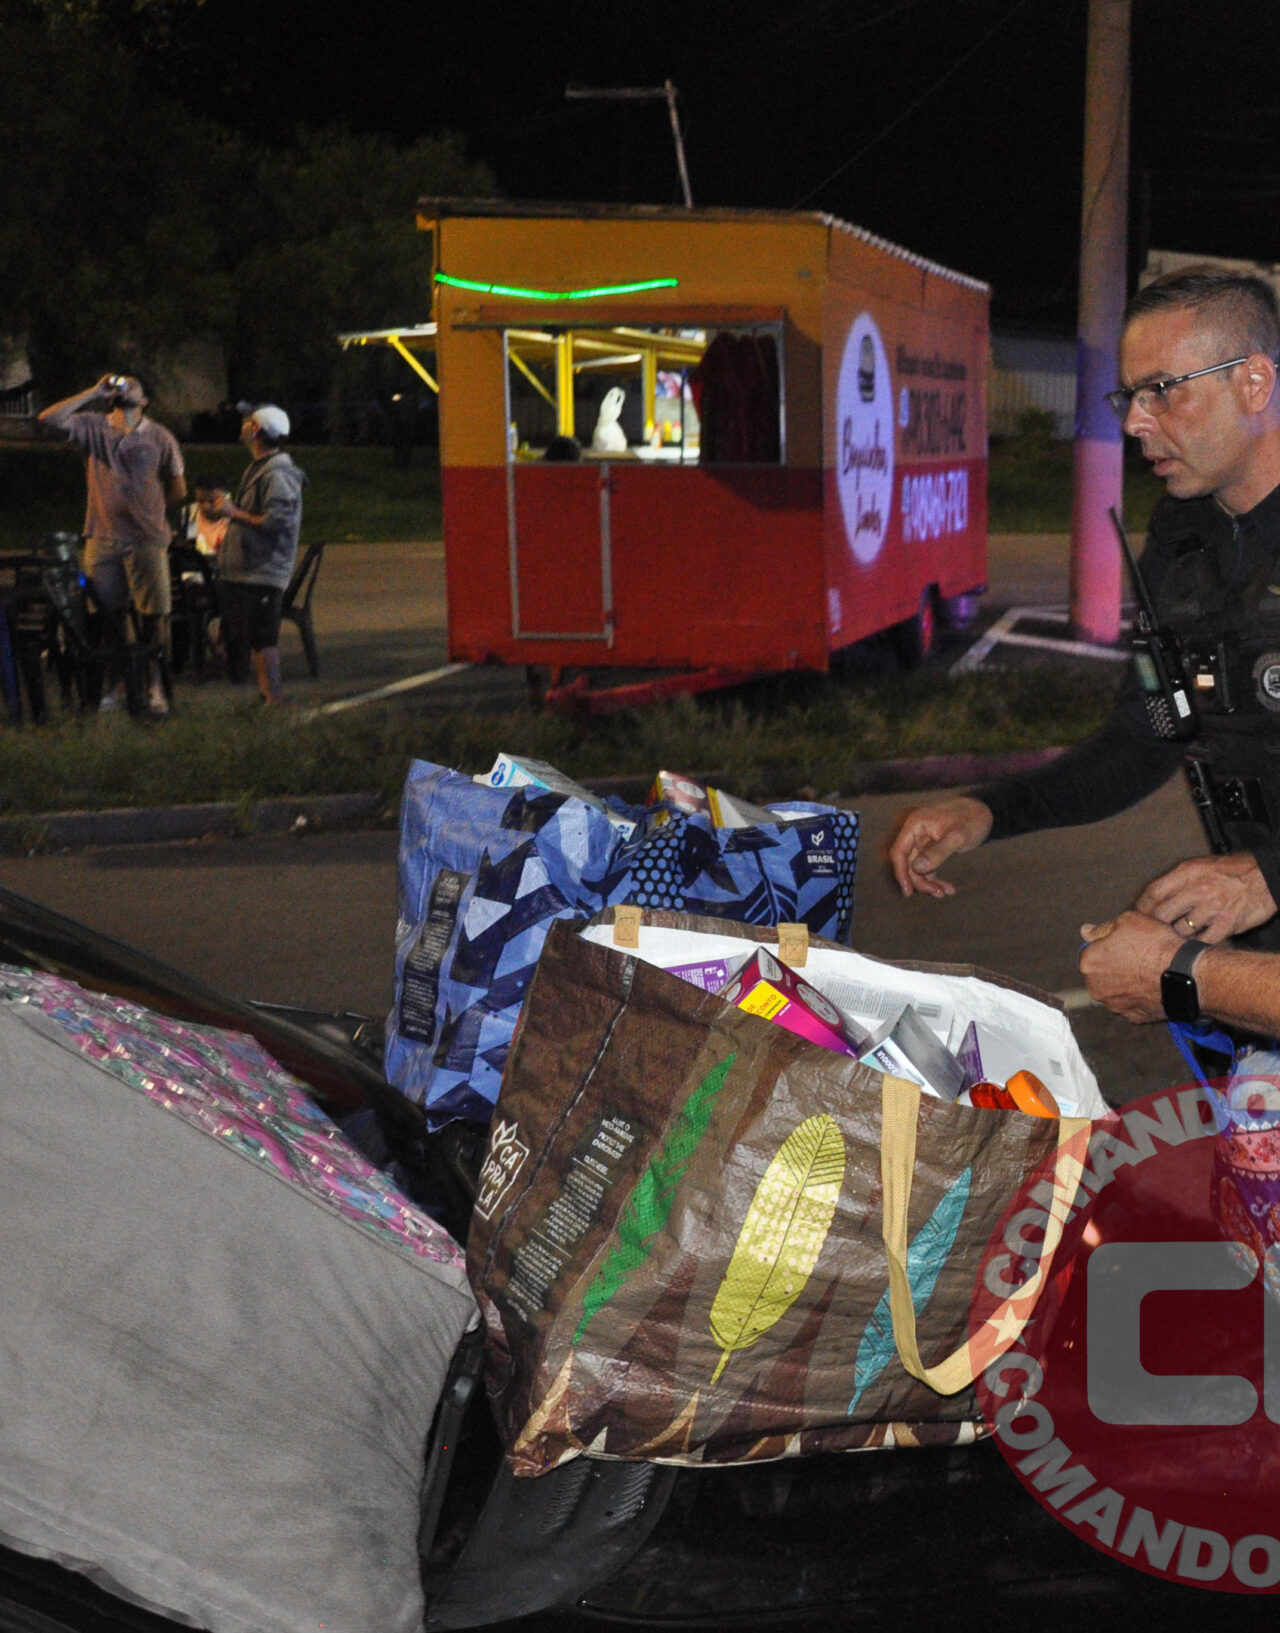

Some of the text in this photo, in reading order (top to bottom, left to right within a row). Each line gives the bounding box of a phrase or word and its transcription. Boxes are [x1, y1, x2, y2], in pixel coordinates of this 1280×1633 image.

[807, 855, 835, 863] BRASIL
[754, 994, 777, 1015] CONTO
[483, 1160, 507, 1188] PRA
